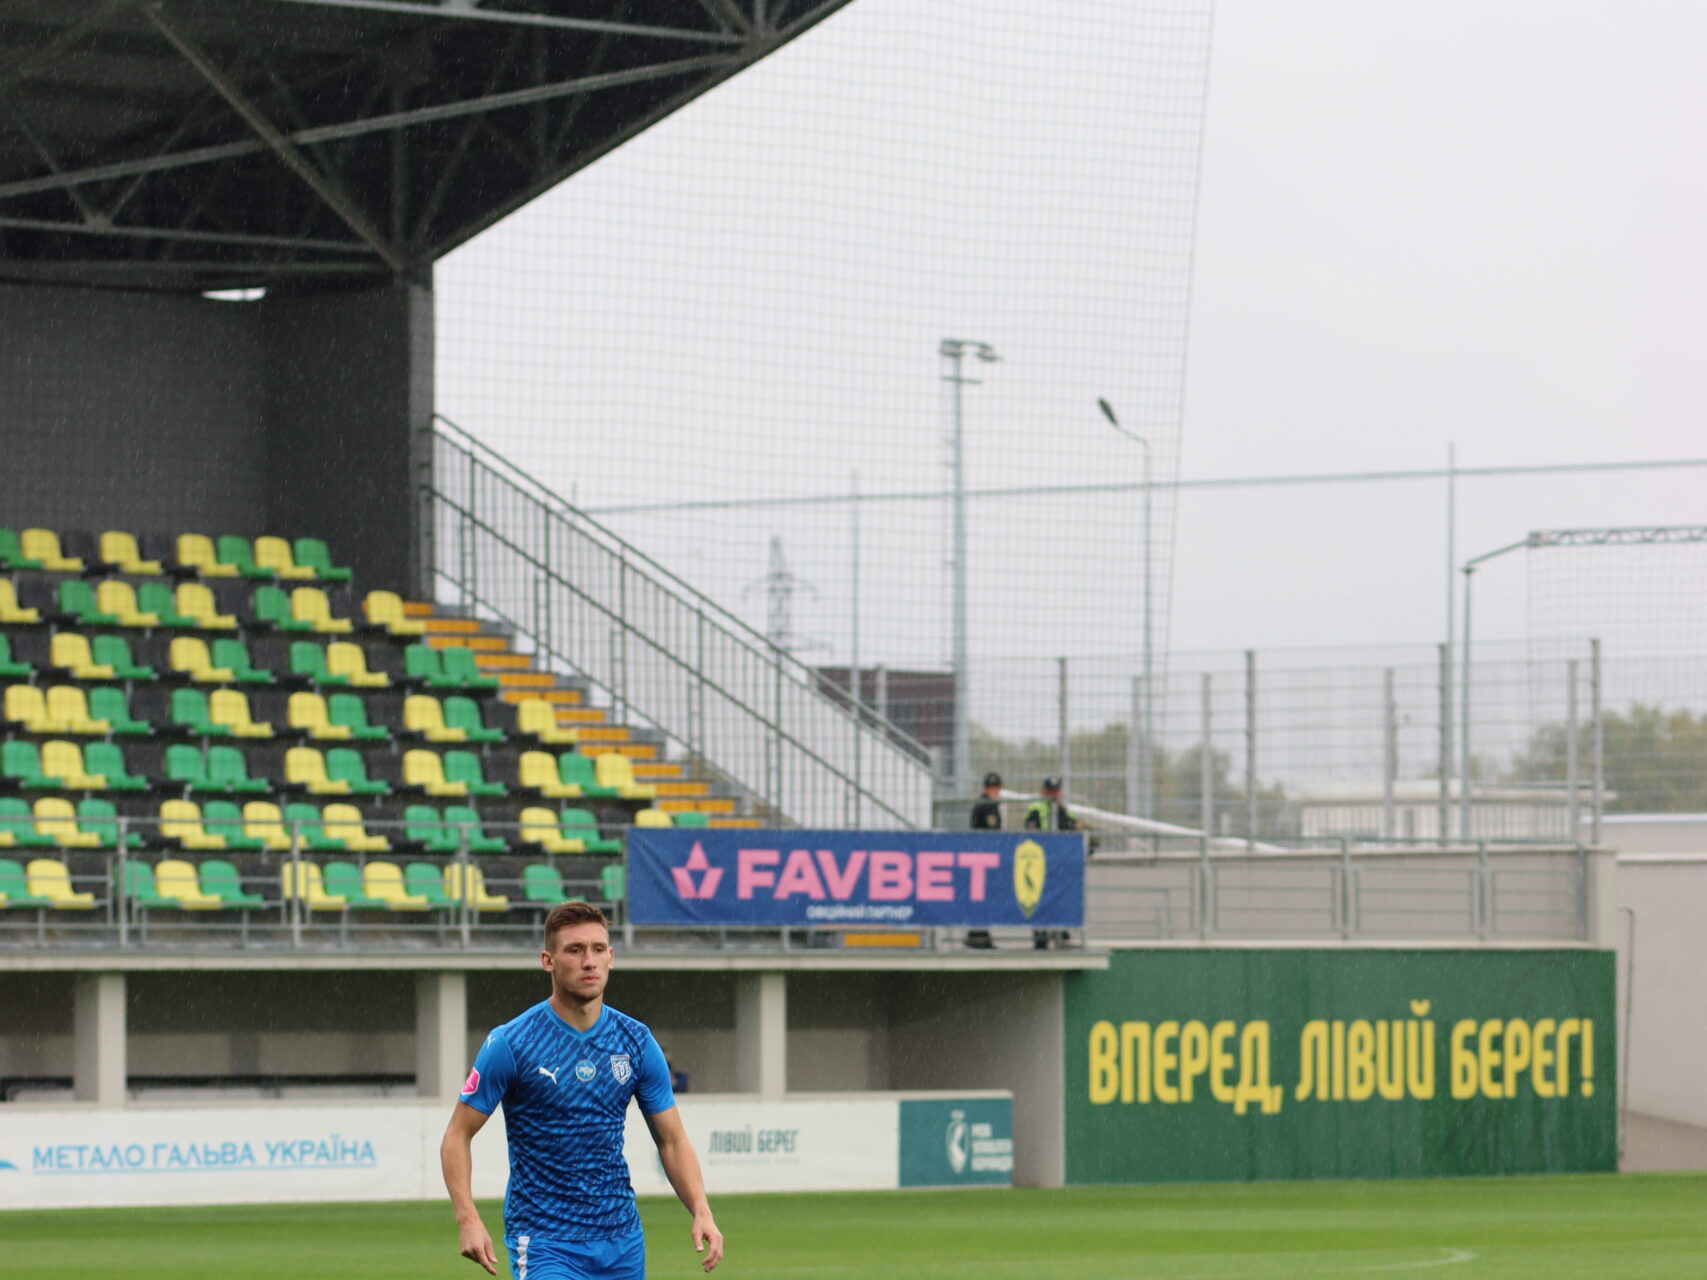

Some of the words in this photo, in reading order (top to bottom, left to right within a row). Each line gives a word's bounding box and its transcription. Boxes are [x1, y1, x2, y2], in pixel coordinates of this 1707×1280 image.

[737, 849, 1000, 900] FAVBET
[1296, 999, 1435, 1101] ЛІВИЙ
[1450, 1018, 1594, 1099] БЕРЕГ!
[32, 1143, 145, 1169] МЕТАЛО
[152, 1141, 256, 1167] ГАЛЬВА
[264, 1134, 376, 1163] УКРАЇНА
[757, 1128, 799, 1153] БЕРЕГ
